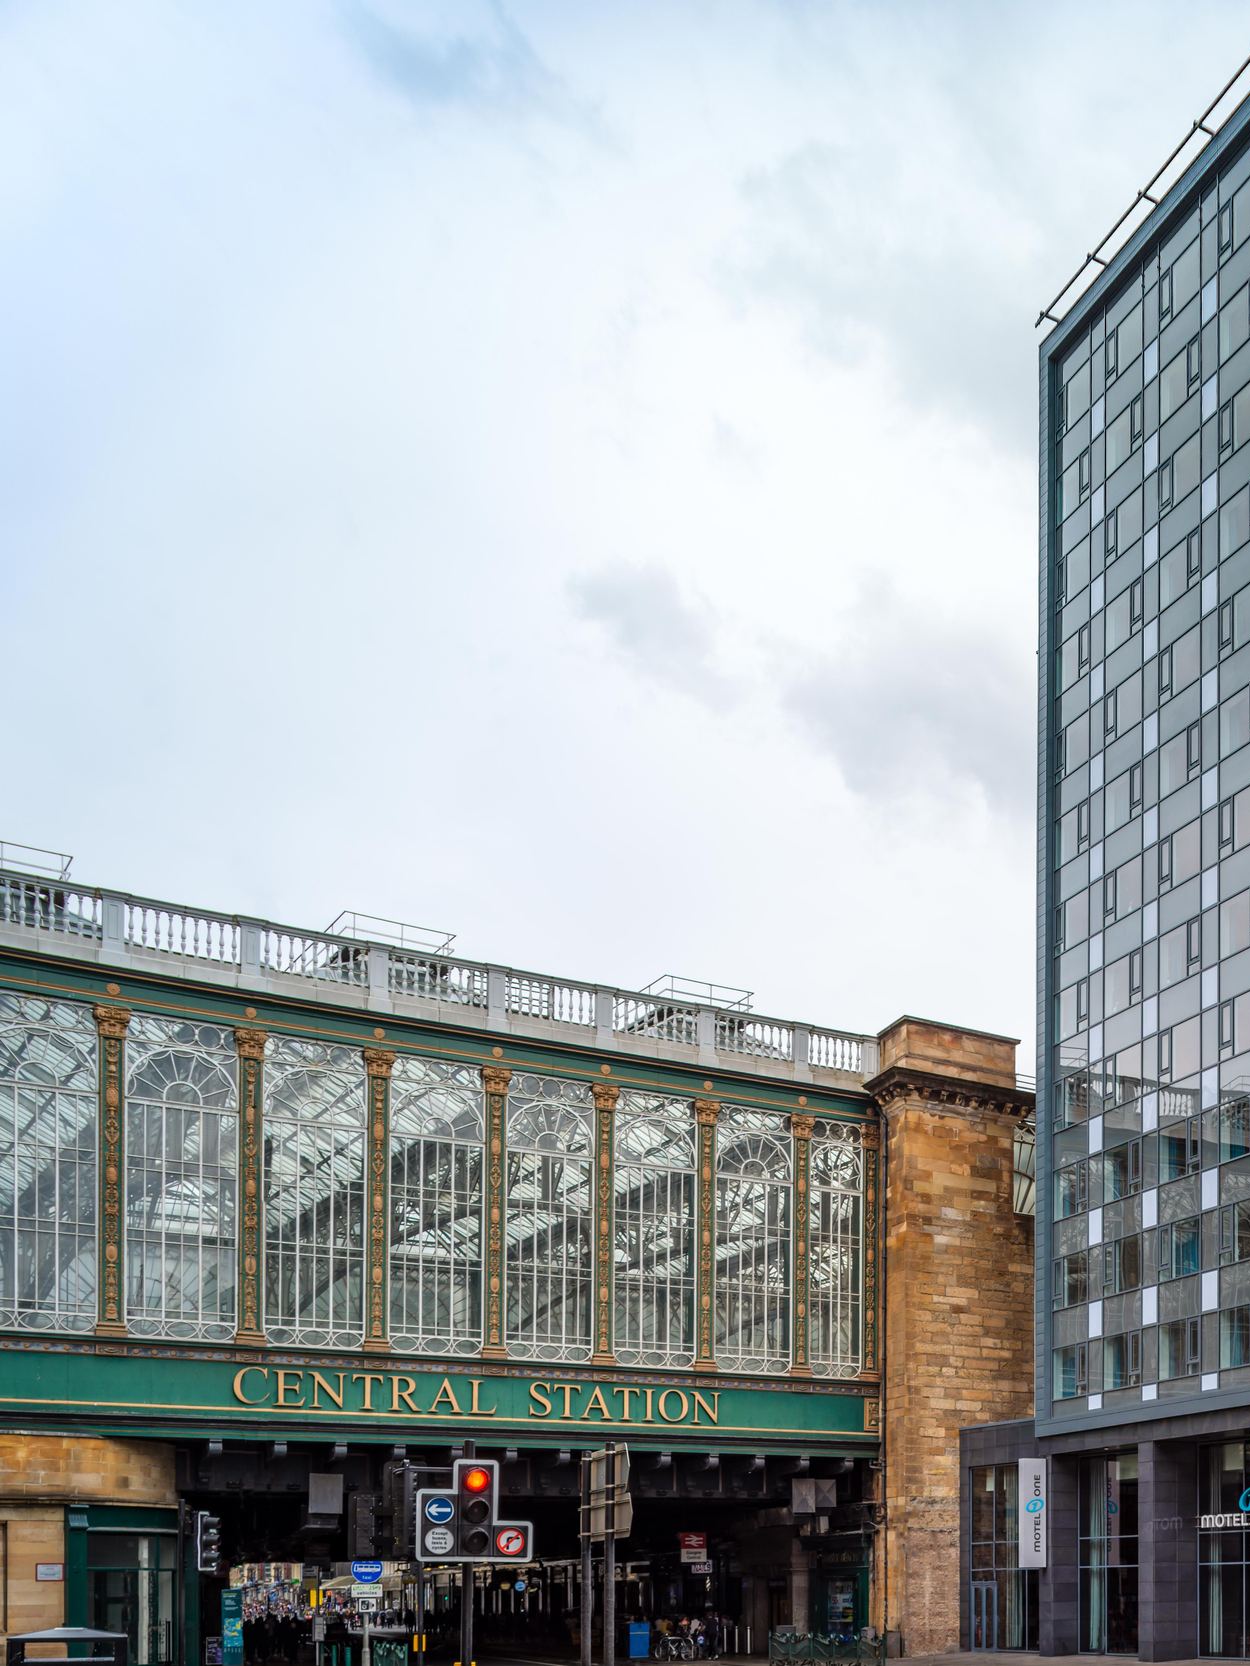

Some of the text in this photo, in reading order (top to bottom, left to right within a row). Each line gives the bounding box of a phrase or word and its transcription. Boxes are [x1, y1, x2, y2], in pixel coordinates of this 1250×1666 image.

[233, 1366, 722, 1425] CENTRAL STATION
[1033, 1474, 1041, 1497] ONE
[1033, 1512, 1041, 1553] MOTEL
[1200, 1512, 1248, 1529] MOTEL
